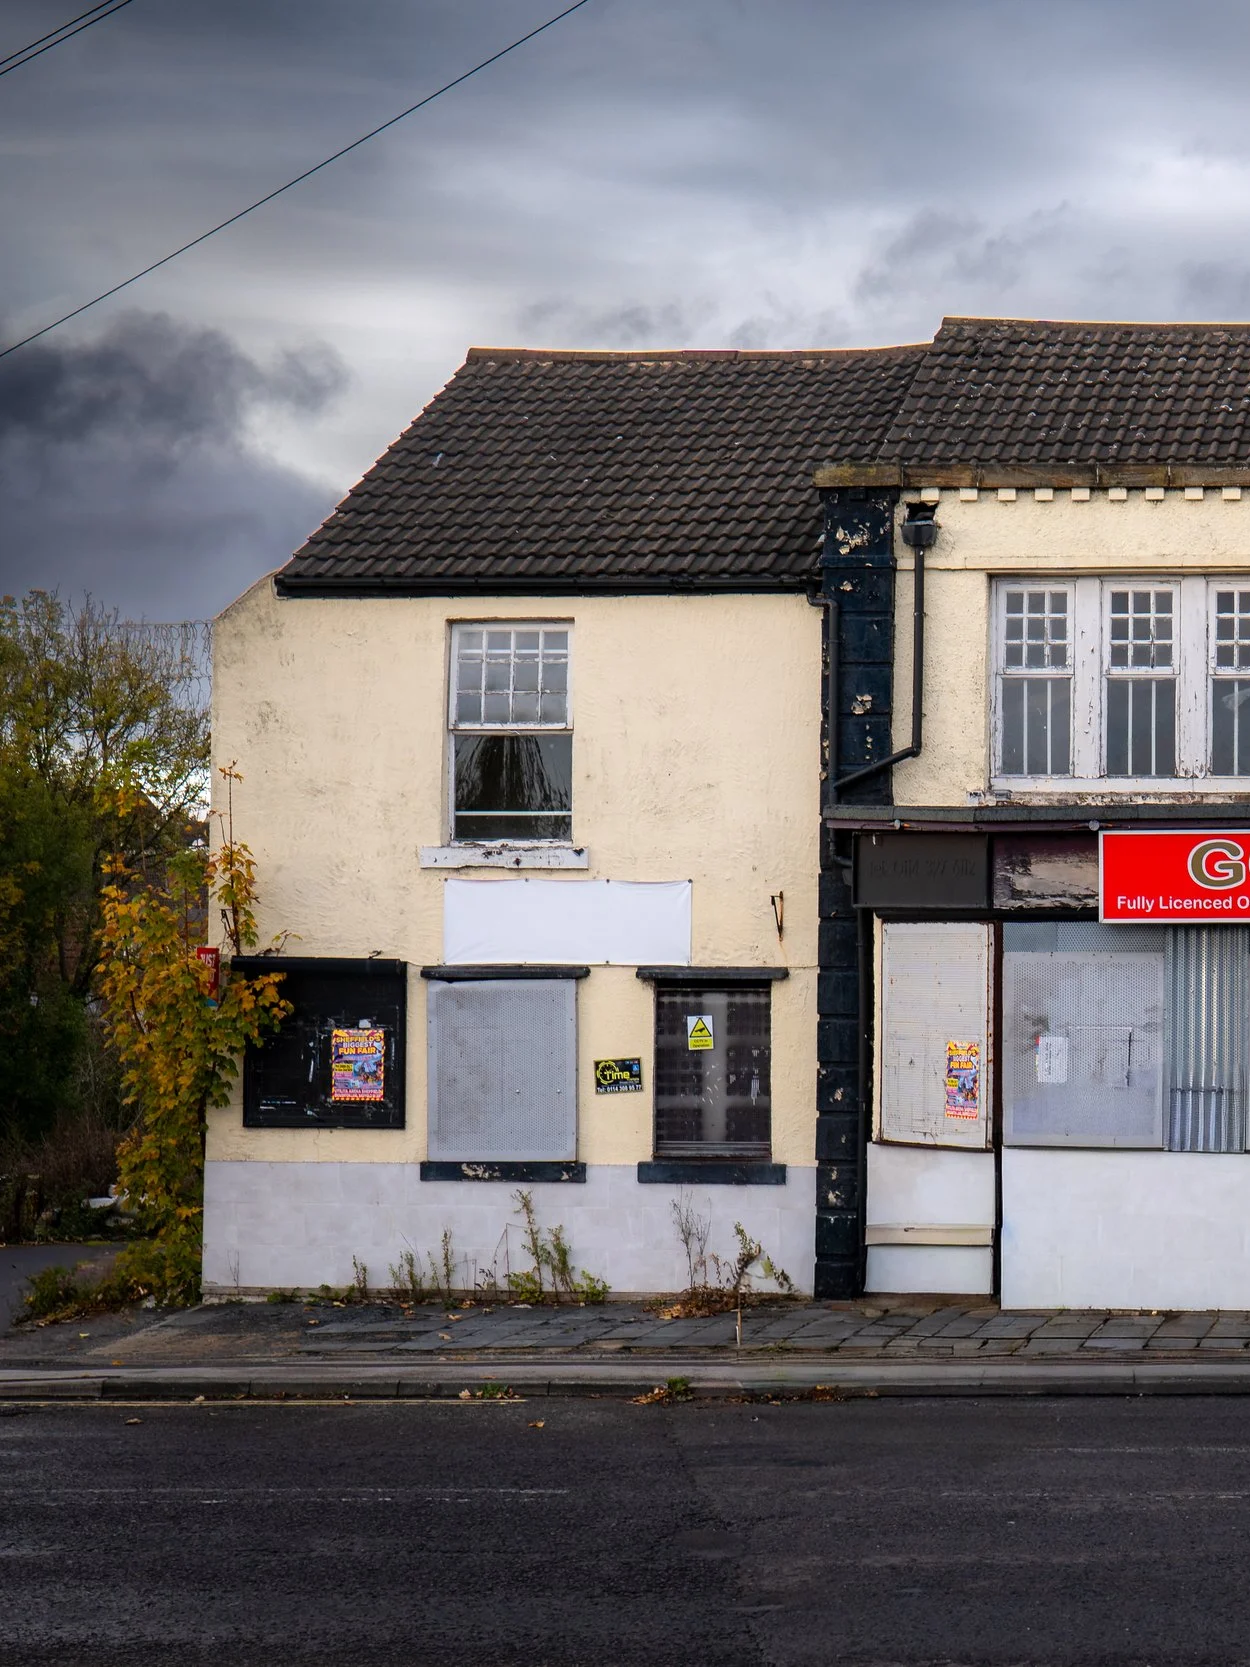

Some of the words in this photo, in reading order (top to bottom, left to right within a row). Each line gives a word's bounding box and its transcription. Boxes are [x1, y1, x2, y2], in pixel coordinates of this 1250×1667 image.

[1117, 895, 1155, 913] Fully
[1159, 895, 1233, 910] Licenced
[604, 1070, 630, 1080] Time
